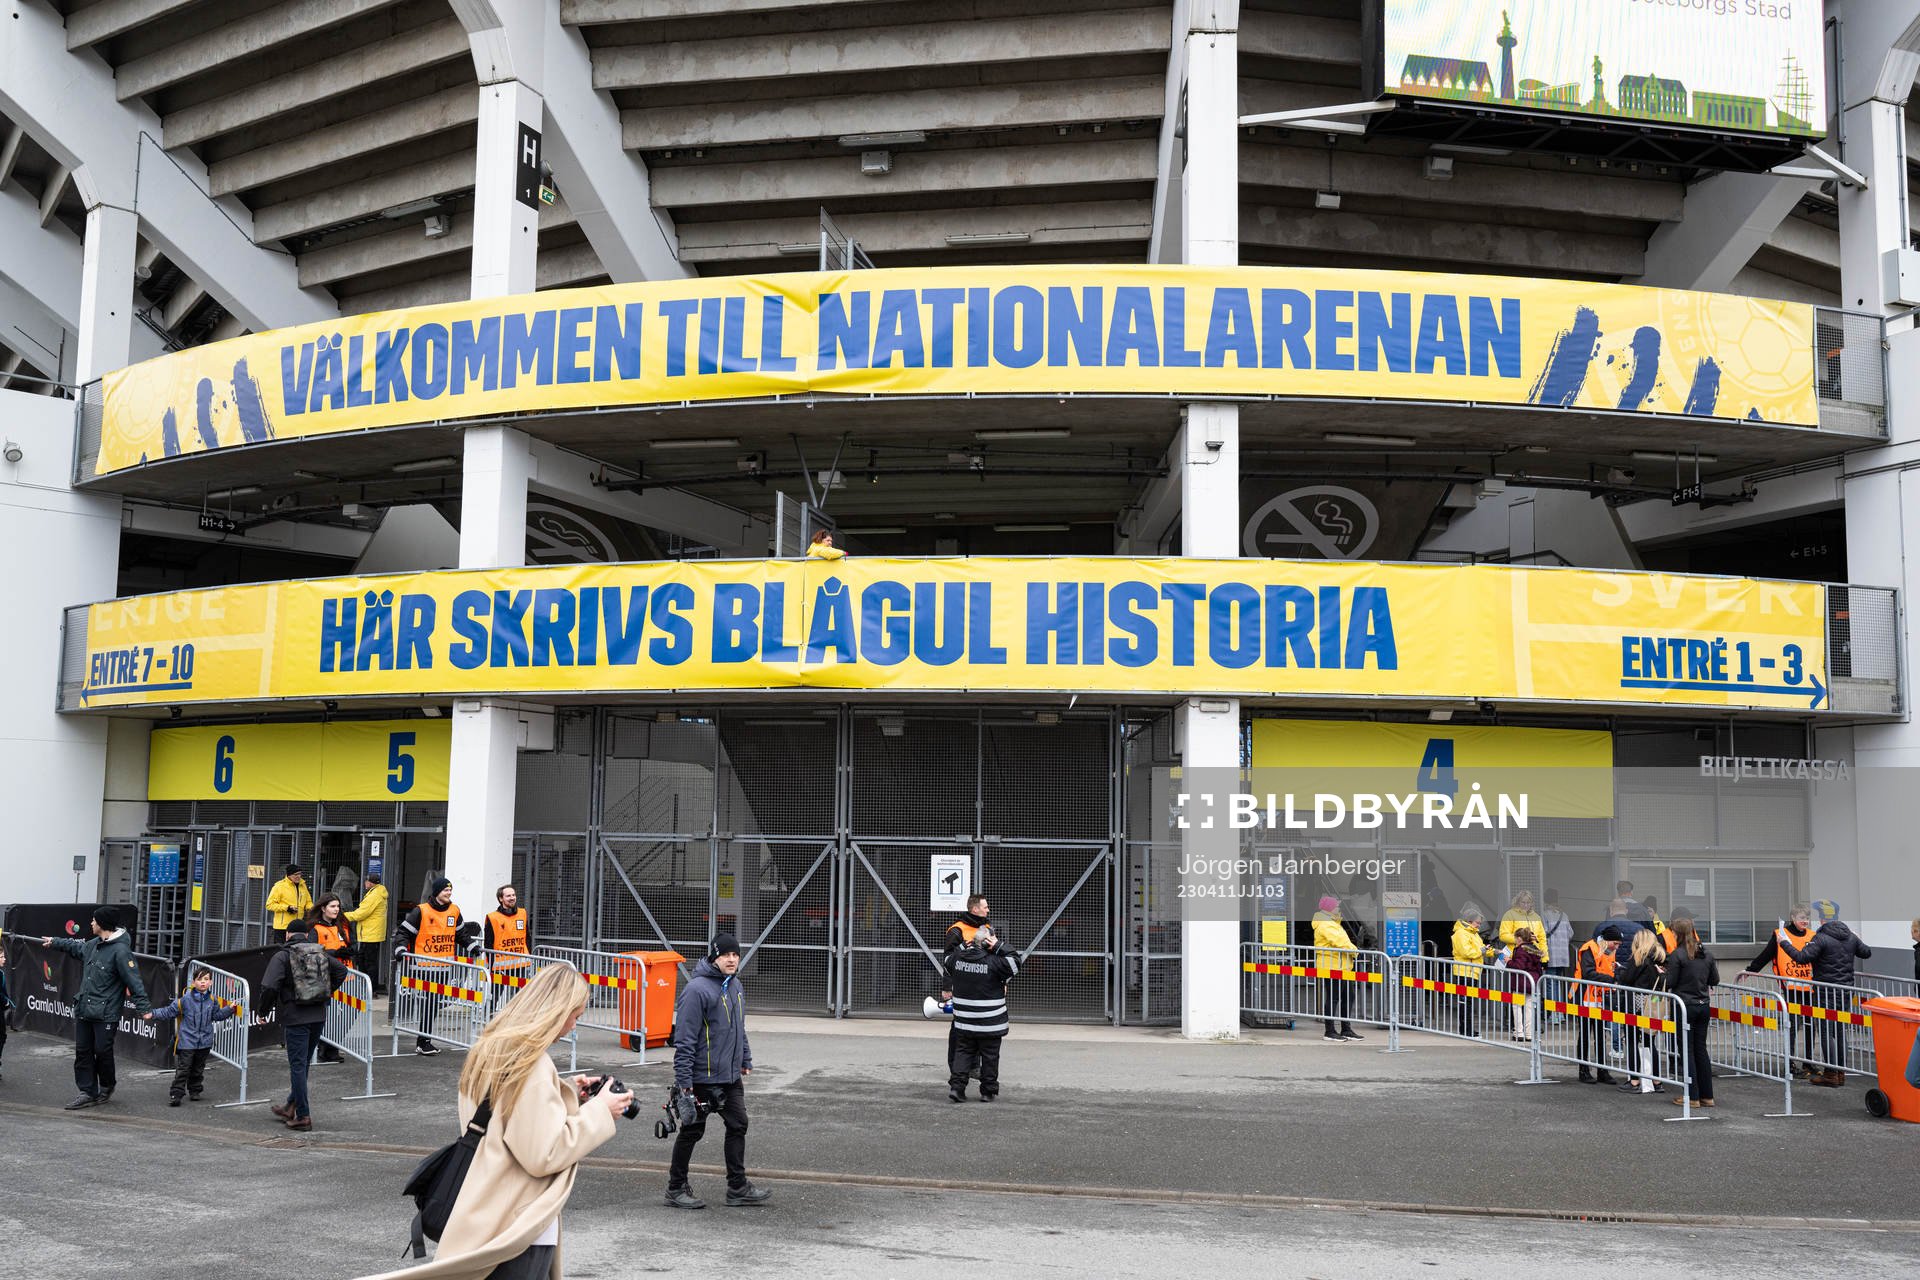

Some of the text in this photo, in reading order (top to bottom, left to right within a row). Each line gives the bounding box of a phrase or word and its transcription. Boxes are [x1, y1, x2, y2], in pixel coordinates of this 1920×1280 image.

[1745, 0, 1791, 19] Stad
[523, 134, 536, 169] H
[525, 188, 531, 198] 1
[280, 302, 643, 416] VÄLKOMMEN
[658, 295, 797, 378] TILL
[817, 285, 1521, 379] NATIONALARENAN
[1682, 486, 1700, 500] F1-5
[201, 517, 224, 529] H1-4
[319, 575, 1398, 673] HÄR SKRIVS BLÅGUL HISTORIA
[90, 646, 140, 687] ENTRÉ
[1621, 636, 1728, 682] ENTRÉ
[213, 731, 416, 795] 6 5
[1416, 738, 1459, 807] 4
[1699, 755, 1850, 783] BILJETTKASSA
[431, 935, 455, 944] SERVIC
[433, 944, 455, 953] SAFET
[501, 937, 525, 947] SERVIC
[955, 960, 989, 974] SUPERVISOR
[27, 995, 76, 1019] Gamla Ullevi
[132, 1018, 157, 1040] Ullevi
